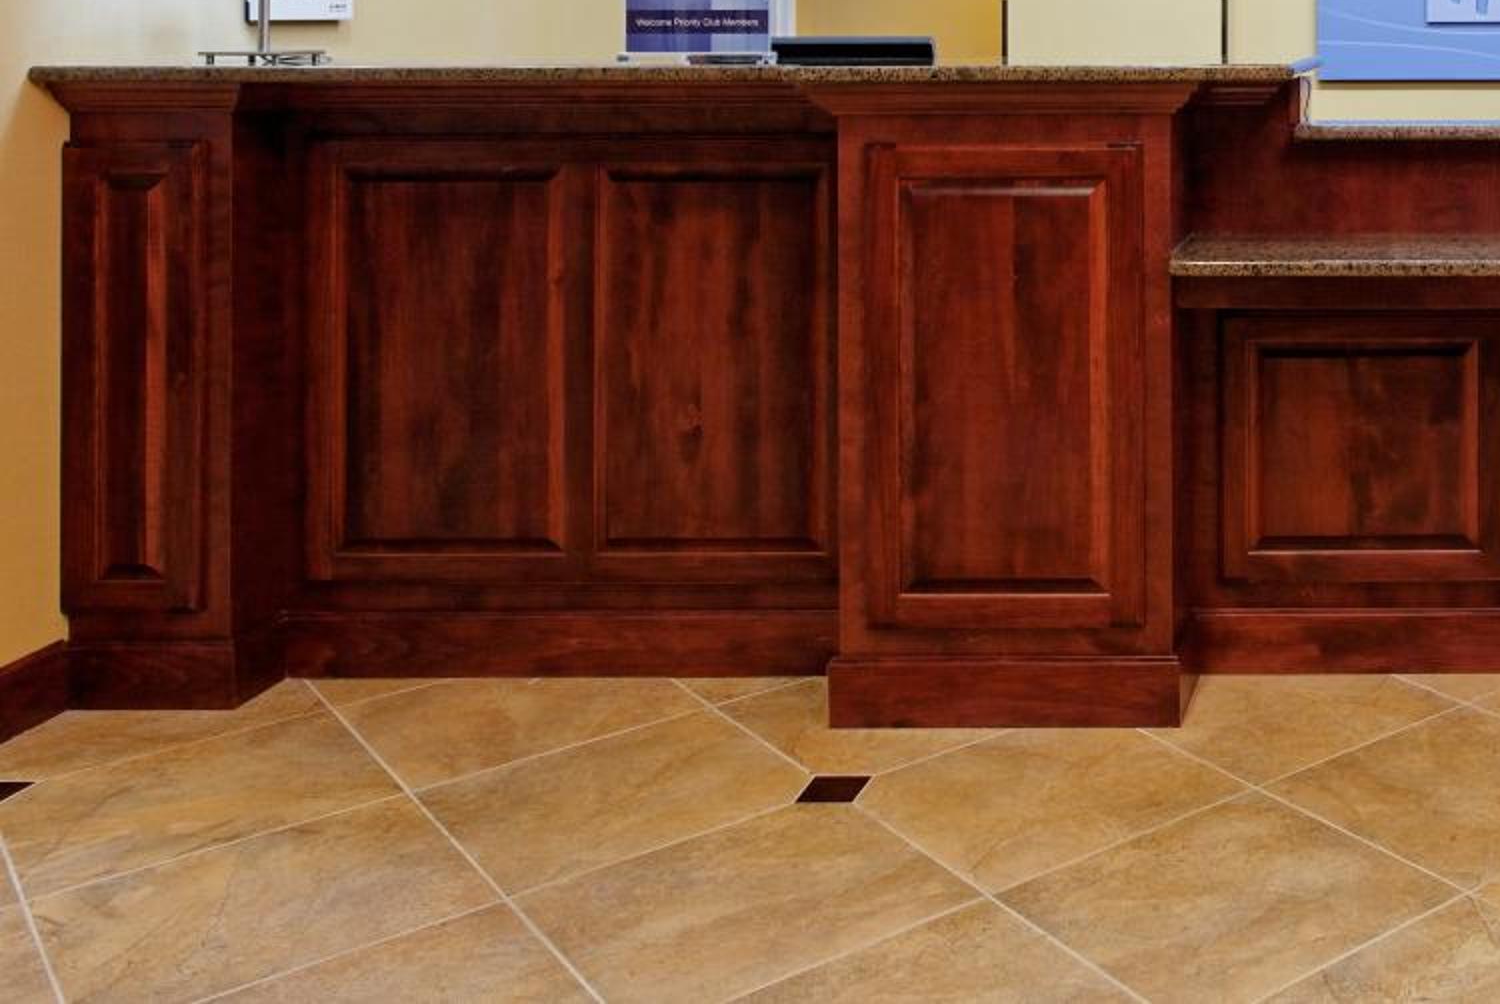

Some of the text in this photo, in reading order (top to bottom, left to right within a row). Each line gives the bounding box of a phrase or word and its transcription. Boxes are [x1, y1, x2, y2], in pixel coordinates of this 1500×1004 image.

[634, 16, 759, 29] Welcome Priority Club Members
